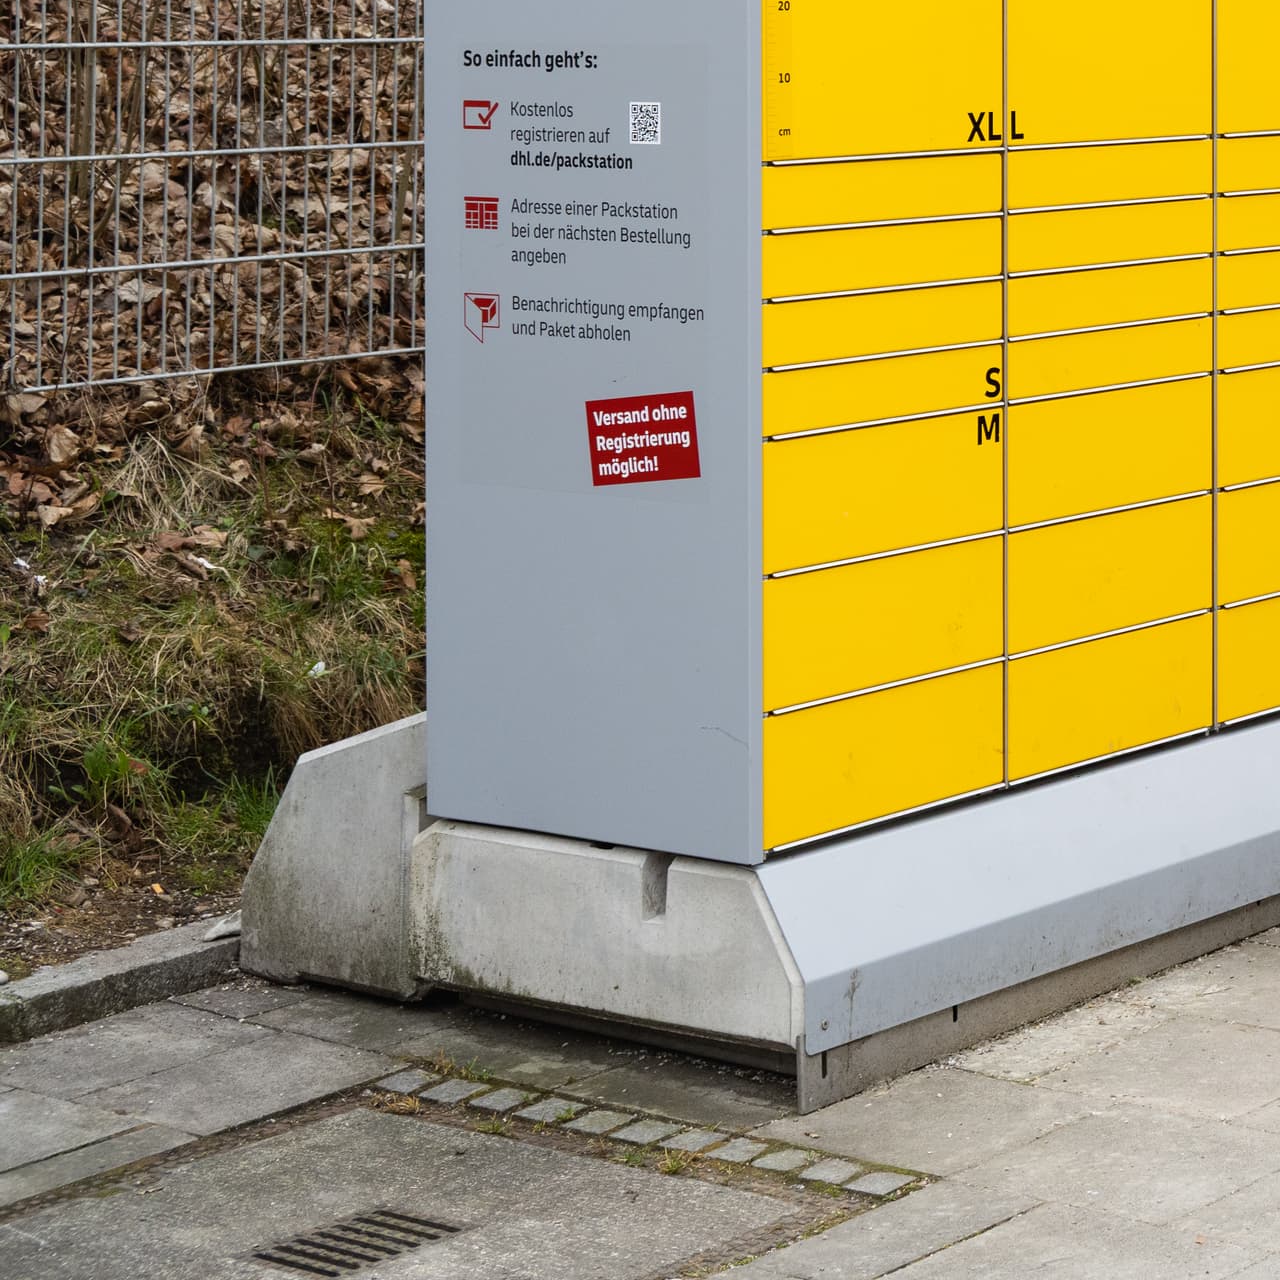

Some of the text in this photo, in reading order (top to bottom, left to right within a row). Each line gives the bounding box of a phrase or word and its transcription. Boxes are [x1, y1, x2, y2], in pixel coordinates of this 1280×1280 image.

[777, 0, 790, 12] 20
[463, 49, 598, 72] So einfach geht’s:
[778, 73, 790, 84] 10
[510, 101, 574, 118] Kostenlos
[510, 126, 611, 145] registrieren auf
[778, 128, 790, 137] cm
[967, 111, 1002, 142] XL
[1010, 110, 1025, 140] L
[510, 150, 633, 172] dhl.de/packstation
[511, 198, 678, 220] Adresse einer Packstation
[511, 222, 691, 249] bei der nächsten Bestellung
[511, 248, 567, 267] angeben
[512, 295, 705, 324] Benachrichtigung empfangen
[512, 321, 631, 342] und Paket abholen
[984, 367, 1001, 398] S
[593, 404, 688, 427] Versand ohne
[977, 413, 1000, 446] M
[596, 430, 691, 454] Registrierung
[598, 456, 659, 478] möglich!
